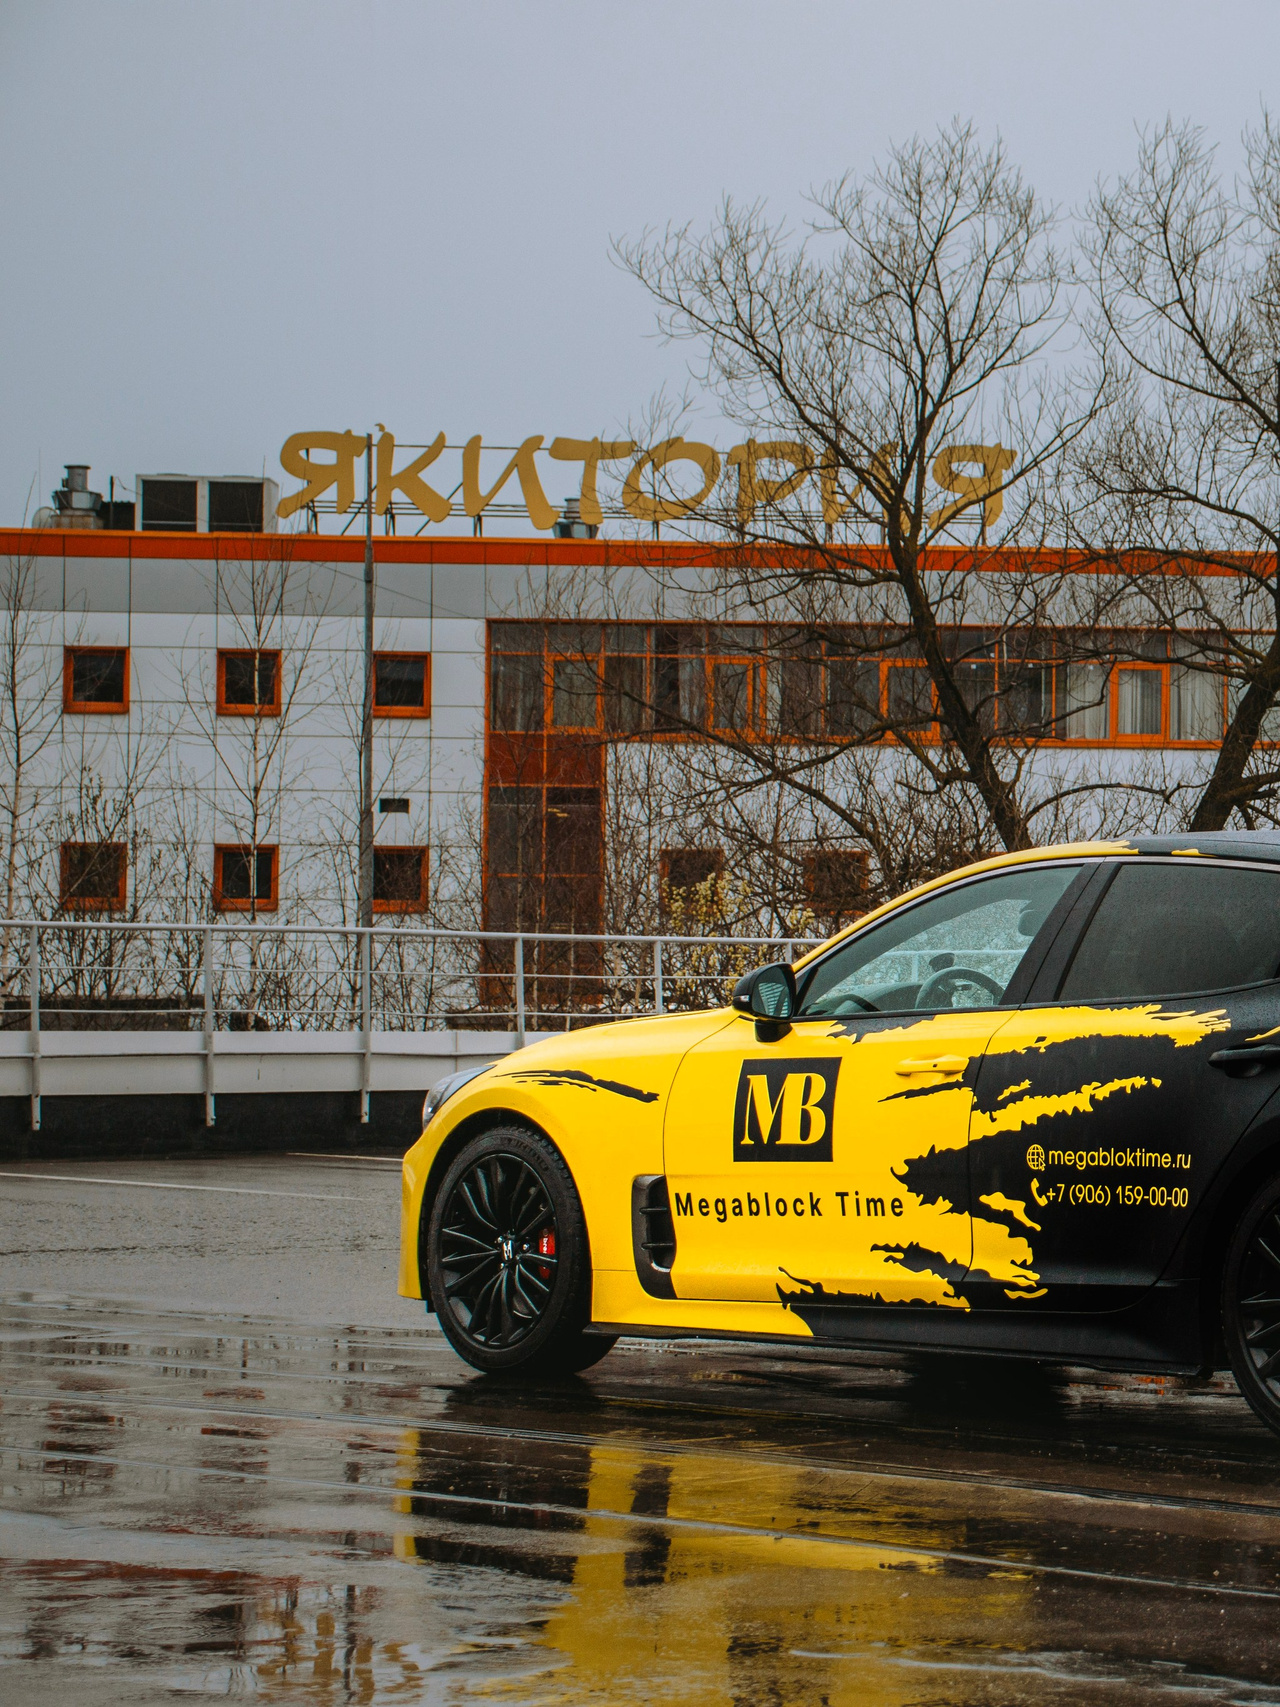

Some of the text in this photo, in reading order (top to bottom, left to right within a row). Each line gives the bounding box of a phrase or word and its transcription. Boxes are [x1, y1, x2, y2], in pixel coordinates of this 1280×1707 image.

[276, 424, 1018, 535] ЯКИТОРИЯ
[740, 1071, 827, 1146] MB
[1048, 1147, 1192, 1171] megabloktime.ru
[675, 1190, 904, 1223] Megablock Time
[1046, 1183, 1189, 1208] +7 (906) 159-00-00
